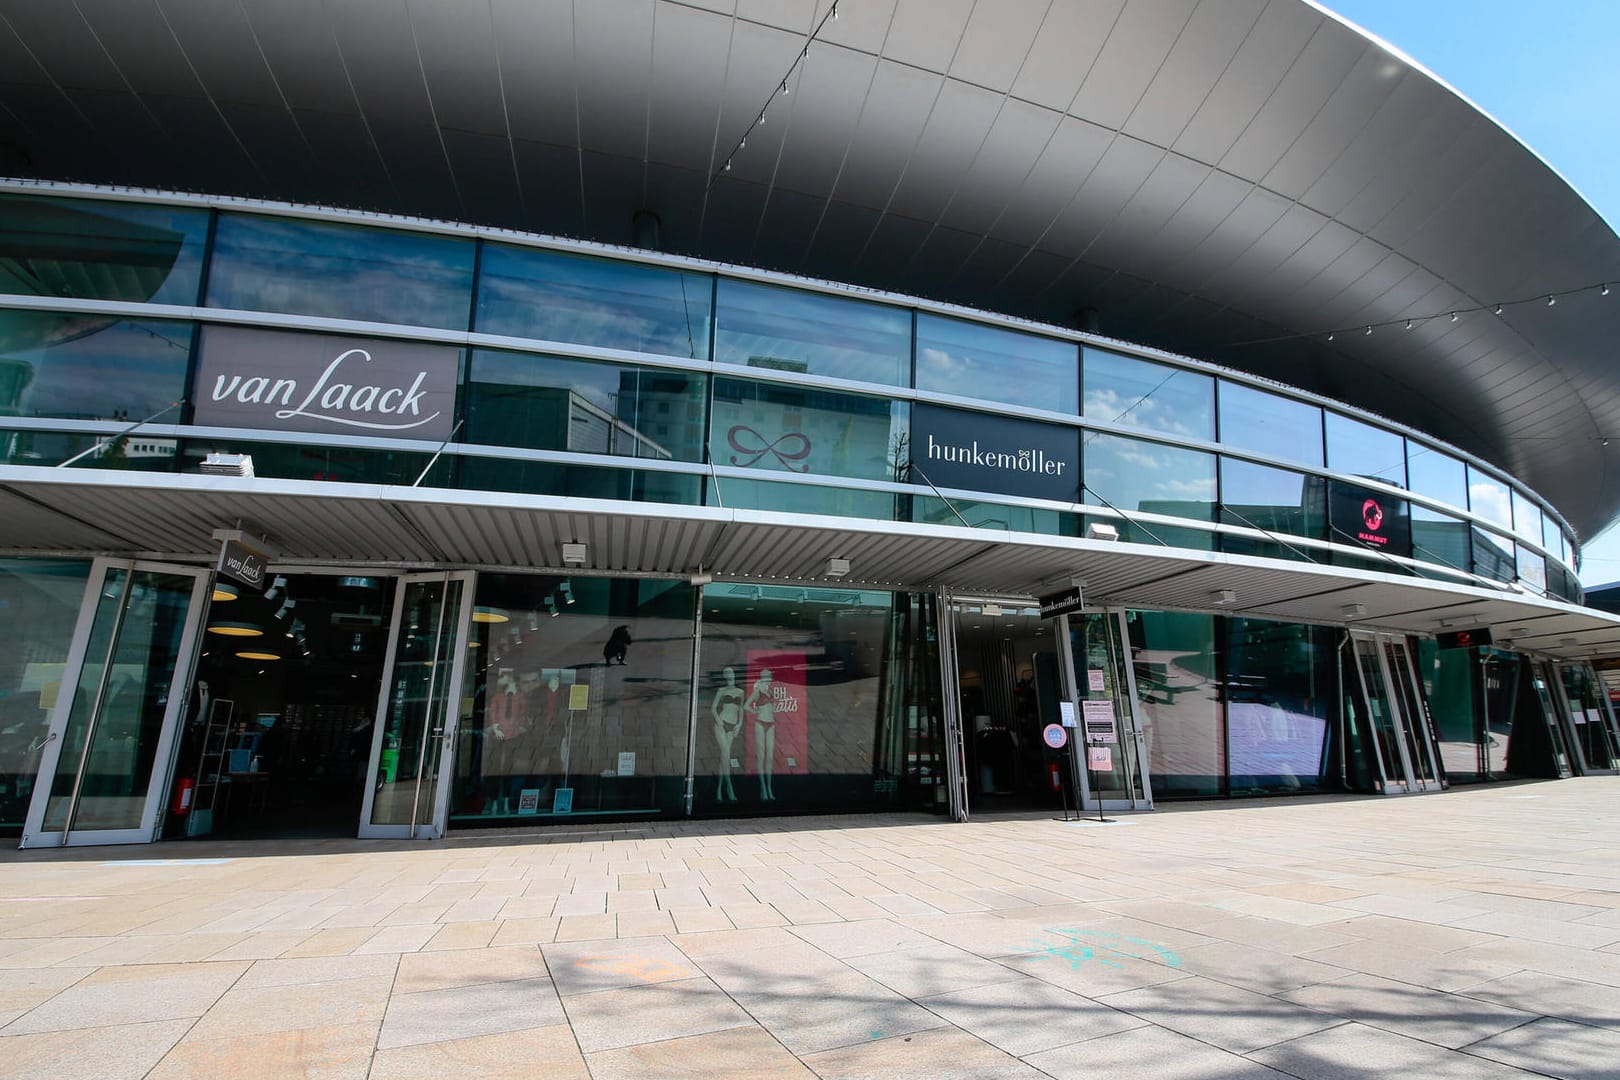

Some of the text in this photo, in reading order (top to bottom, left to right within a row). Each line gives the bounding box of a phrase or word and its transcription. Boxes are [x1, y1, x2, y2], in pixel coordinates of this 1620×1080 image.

[212, 349, 440, 429] van Laack
[928, 434, 1066, 476] hunkemöller
[227, 556, 241, 571] van
[773, 687, 787, 699] BH
